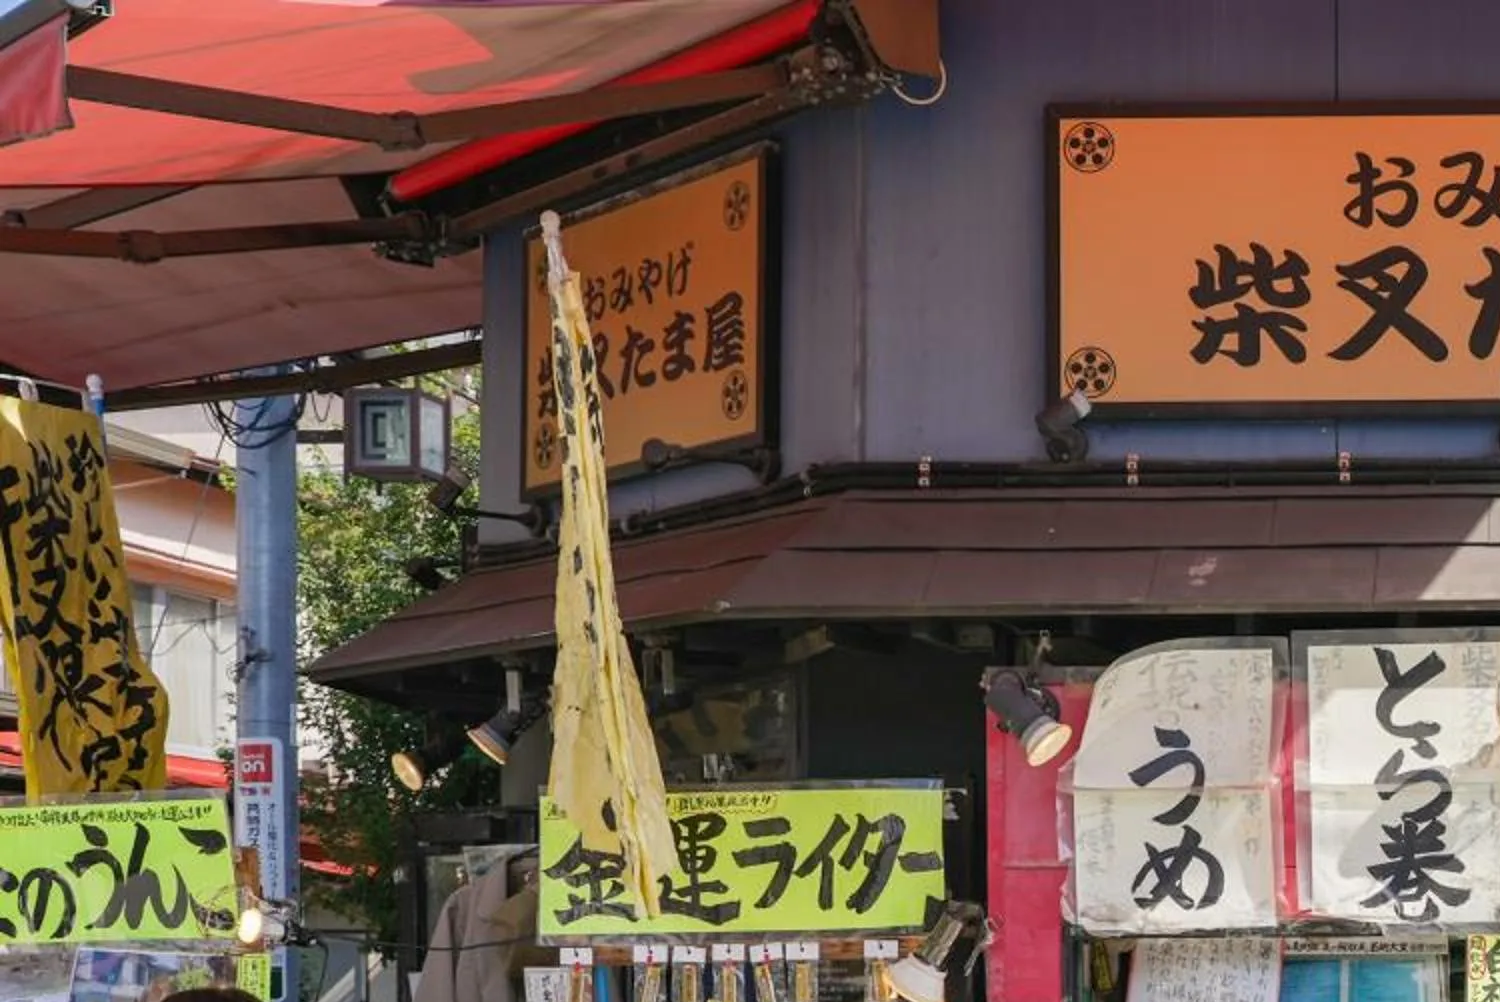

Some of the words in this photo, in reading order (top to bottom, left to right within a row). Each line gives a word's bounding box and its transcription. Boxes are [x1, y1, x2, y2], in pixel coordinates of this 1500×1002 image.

[585, 242, 693, 322] おみやげ
[1127, 725, 1224, 911] うめ
